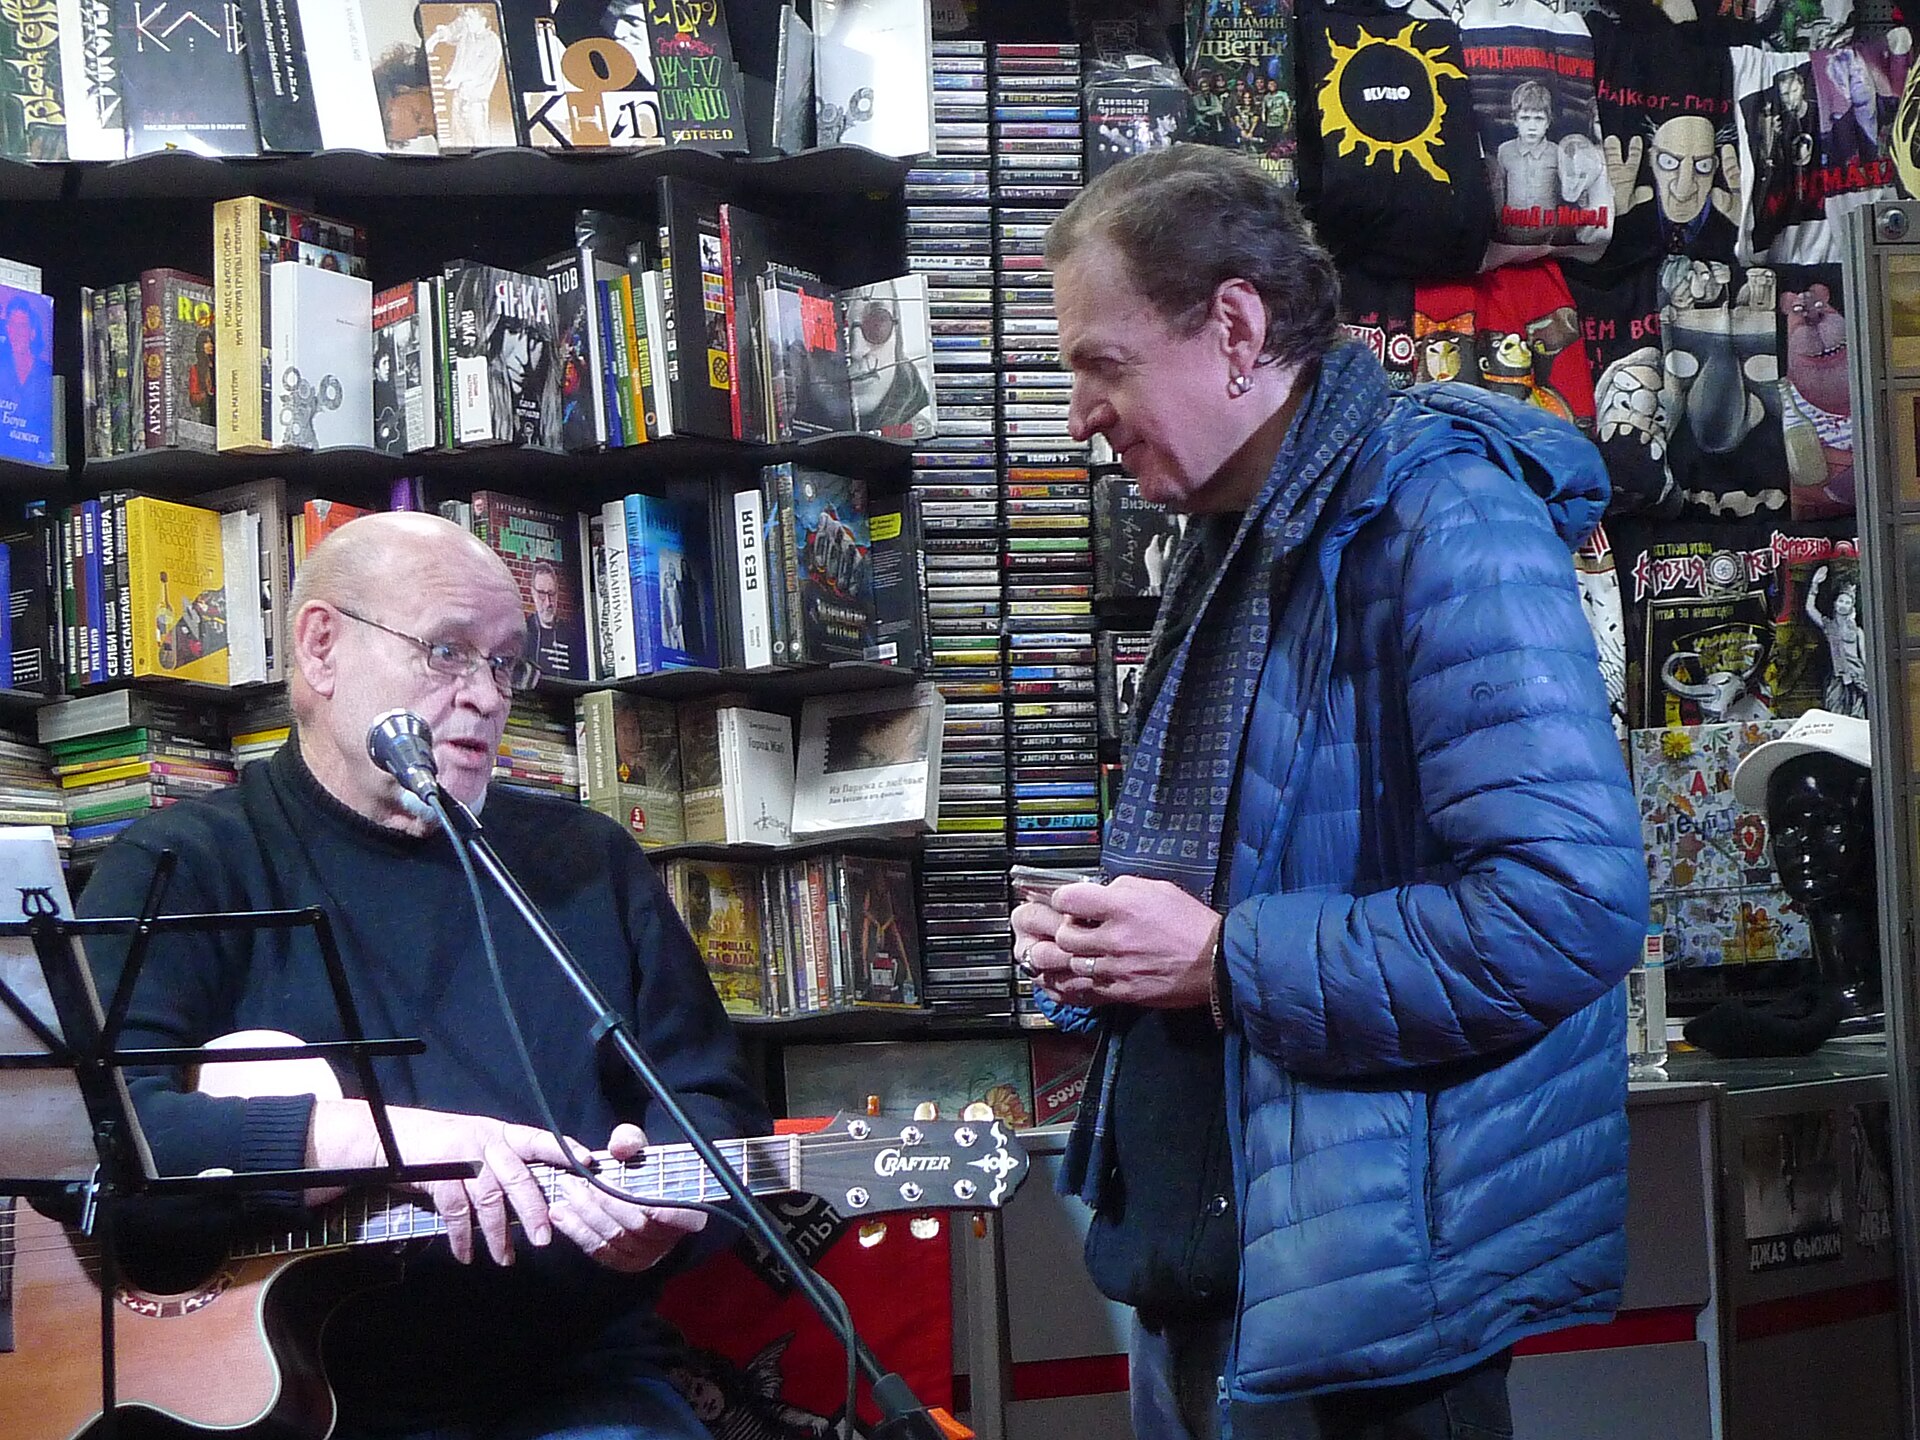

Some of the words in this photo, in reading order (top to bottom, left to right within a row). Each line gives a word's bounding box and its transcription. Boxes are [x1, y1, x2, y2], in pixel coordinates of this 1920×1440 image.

[4, 47, 67, 130] Black
[549, 267, 579, 295] ТОВ
[101, 509, 115, 566] КАМЕРА
[741, 509, 755, 547] БЛЯ
[607, 546, 625, 633] АКВАРИУМА
[744, 555, 758, 591] БЕЗ
[119, 586, 134, 676] КОНСТАНТАЙН
[106, 633, 119, 677] СЕЛБИ
[829, 785, 840, 795] Из
[842, 781, 876, 796] Парижа
[874, 1148, 951, 1177] CRAFTER
[1750, 1241, 1787, 1272] ДЖАЗ
[1792, 1233, 1842, 1261] ФЬЮЖН
